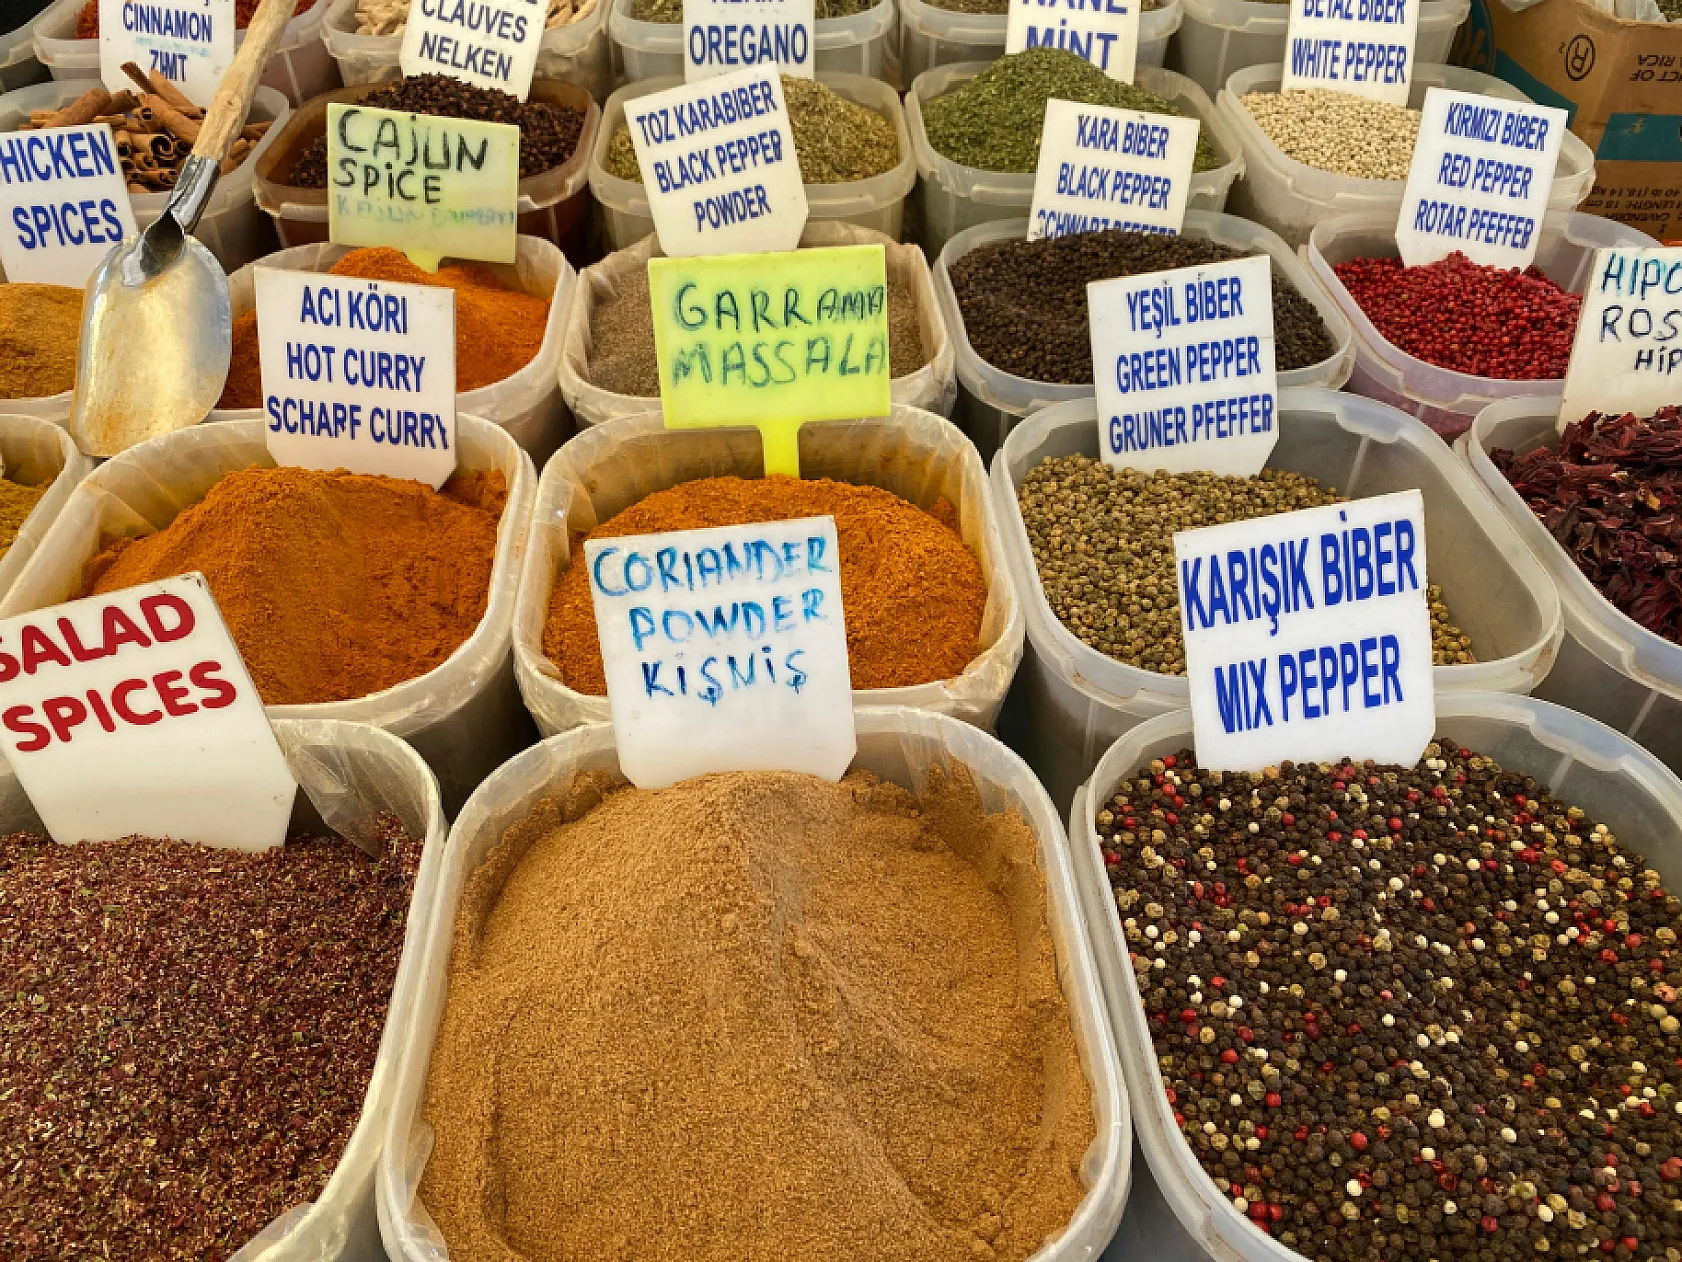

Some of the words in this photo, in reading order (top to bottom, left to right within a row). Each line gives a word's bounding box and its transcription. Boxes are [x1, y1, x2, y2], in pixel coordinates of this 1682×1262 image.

[122, 1, 212, 42] CINNAMON
[420, 0, 529, 43] CLAUVES
[689, 23, 809, 65] OREGANO
[418, 30, 513, 82] NELKEN
[1291, 38, 1342, 79] WHITE
[1343, 42, 1407, 83] PEPPER
[635, 109, 676, 147] TOZ
[1076, 114, 1119, 152] KARA
[1444, 101, 1503, 142] KIRMIZI
[0, 130, 117, 184] HICKEN
[653, 149, 716, 193] BLACK
[715, 129, 783, 177] PEPPER
[1437, 152, 1471, 188] RED
[1472, 158, 1533, 199] PEPPER
[694, 184, 771, 232] POWDER
[1056, 162, 1111, 201] BLACK
[1111, 170, 1171, 210] PEPPER
[13, 198, 124, 250] SPICES
[1413, 199, 1467, 238] ROTAR
[1466, 207, 1535, 249] PFEFFER
[300, 285, 341, 327] ACI
[347, 282, 408, 335] KÖRI
[286, 341, 336, 383] HOT
[343, 348, 425, 393] CURRY
[671, 332, 886, 388] MASSALA
[1116, 347, 1181, 394] GREEN
[1186, 335, 1261, 384] PEPPER
[1109, 406, 1188, 454] GRUNER
[1192, 393, 1274, 442] PFEFFER
[593, 535, 833, 597] CORIANDER
[1182, 537, 1315, 636] KARIŞIK
[628, 588, 829, 651] POWDER
[1, 660, 238, 752] SPICES
[1214, 657, 1274, 734] MIX
[1278, 634, 1404, 722] PEPPER
